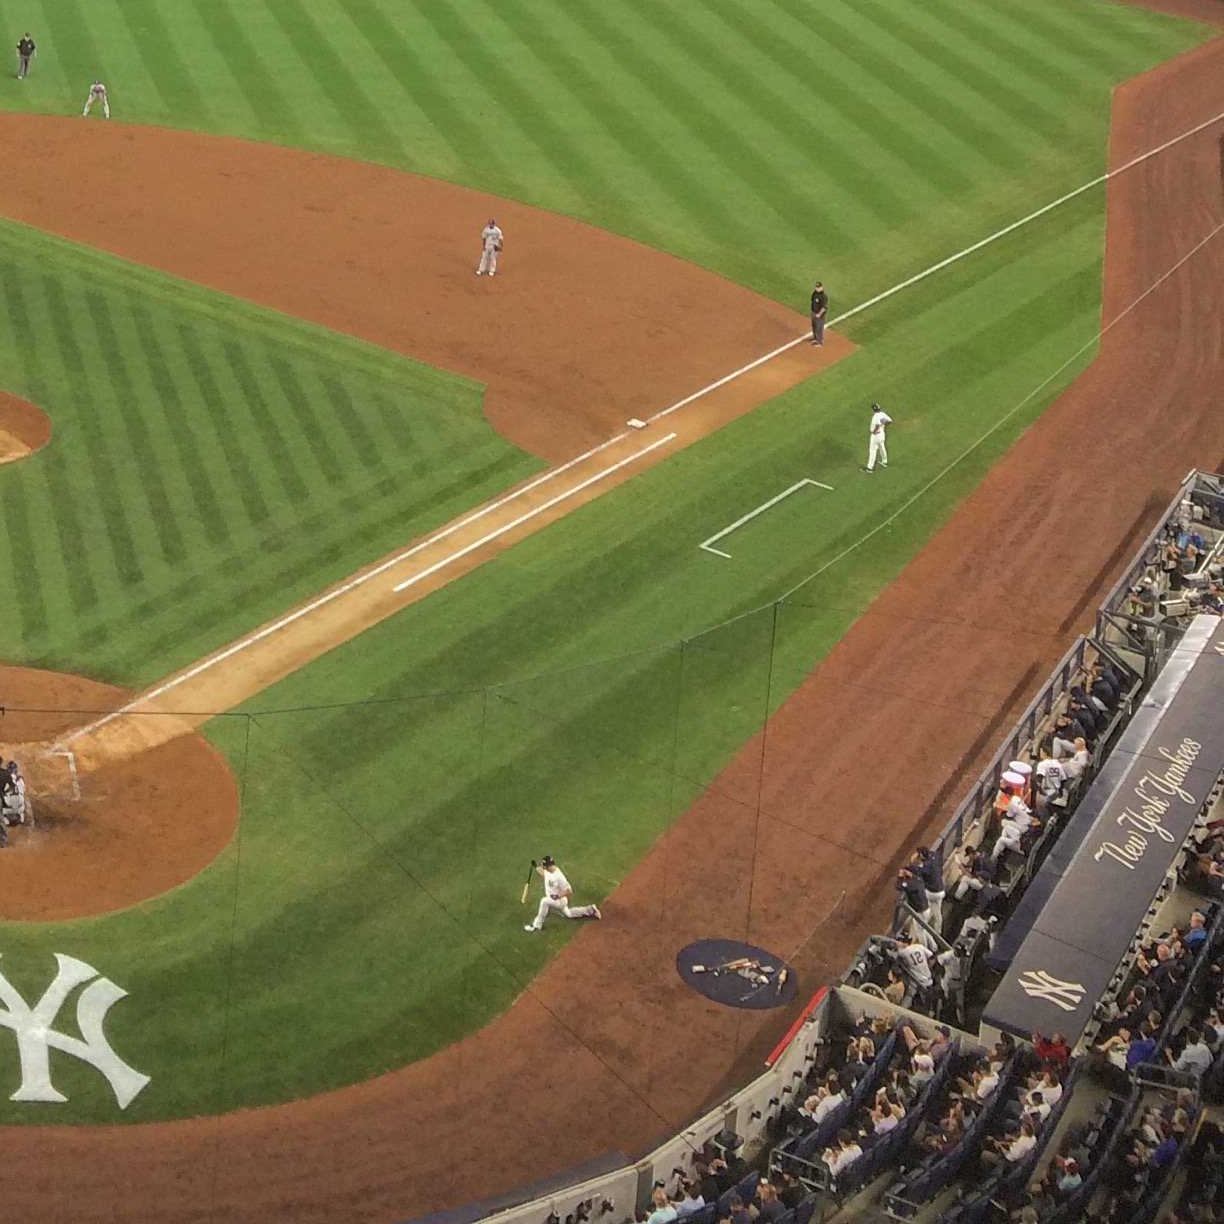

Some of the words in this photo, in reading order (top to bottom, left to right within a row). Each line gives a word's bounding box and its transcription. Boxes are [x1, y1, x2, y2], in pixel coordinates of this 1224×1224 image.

[1158, 736, 1202, 805] Yankees
[1117, 774, 1174, 842] York
[1094, 831, 1149, 870] New
[910, 951, 924, 966] 12
